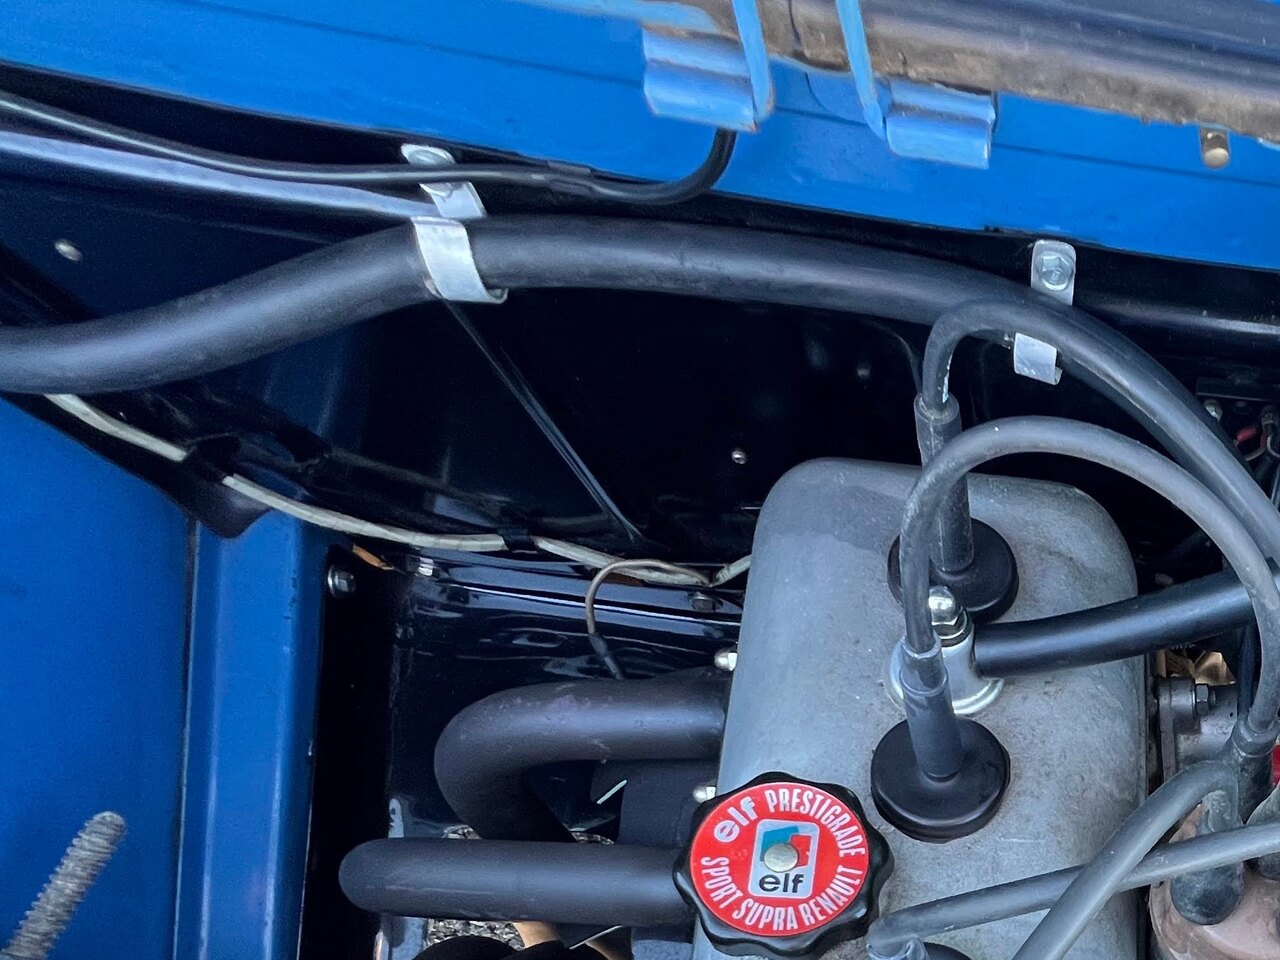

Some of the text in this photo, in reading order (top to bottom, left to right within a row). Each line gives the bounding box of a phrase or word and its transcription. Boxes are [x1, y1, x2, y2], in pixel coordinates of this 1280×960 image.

[713, 788, 867, 858] elf PRESTIGRADE
[700, 856, 864, 931] SPORT SUPRA RENAULT
[758, 872, 804, 893] elf
